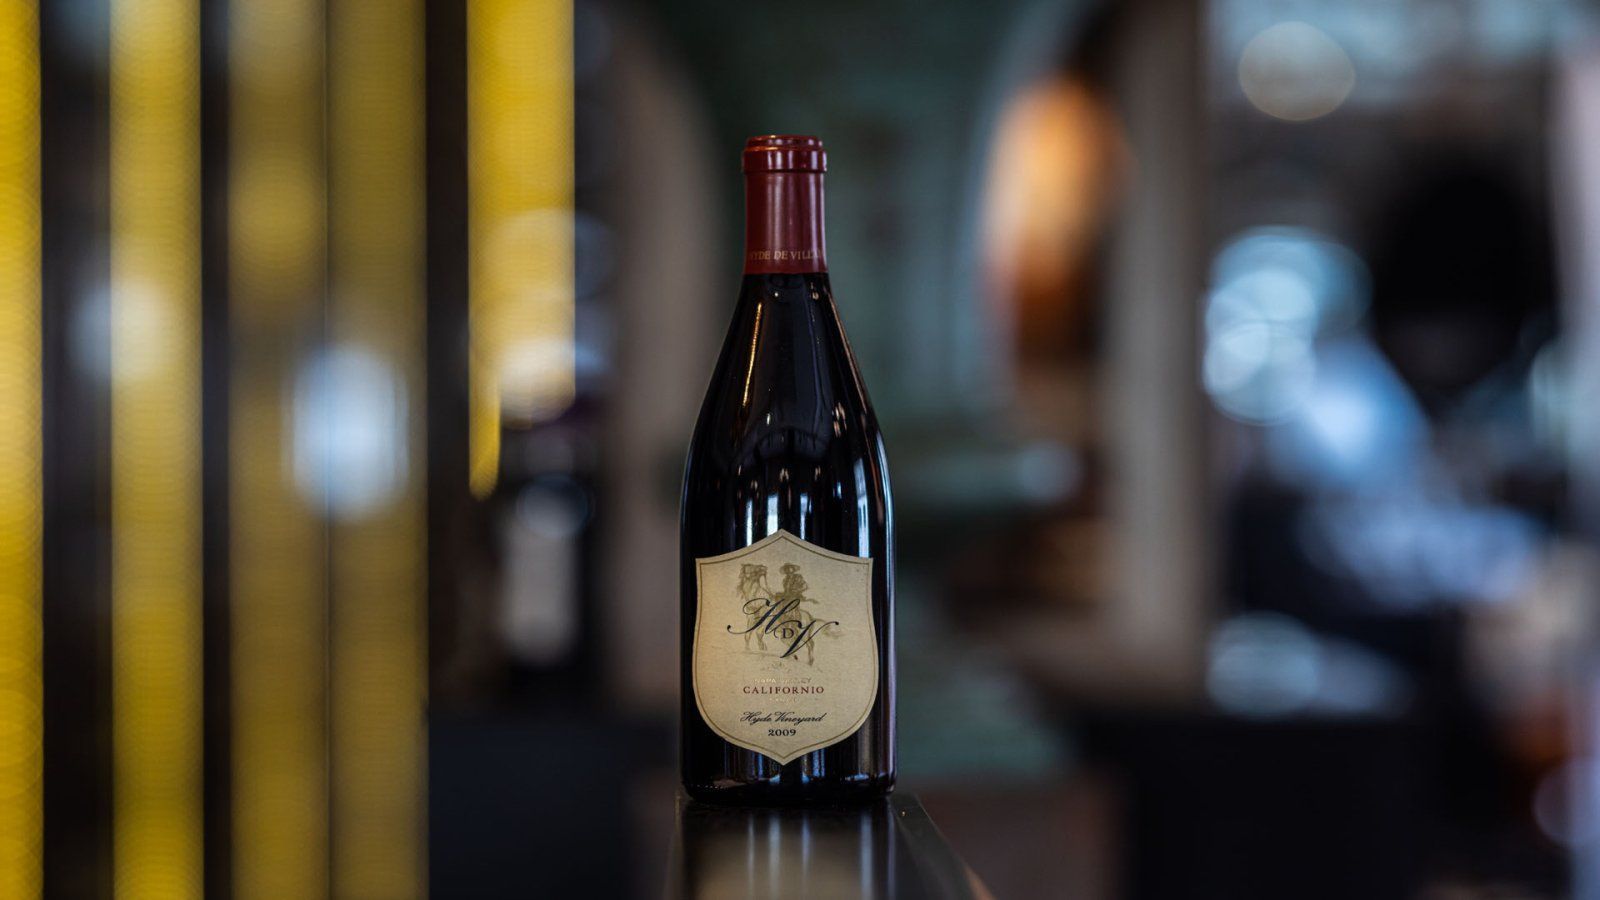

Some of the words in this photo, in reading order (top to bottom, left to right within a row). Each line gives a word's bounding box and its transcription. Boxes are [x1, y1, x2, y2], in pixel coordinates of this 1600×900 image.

[774, 250, 788, 260] DE
[742, 685, 825, 695] CALIFORNIO
[740, 711, 773, 726] Hyde
[773, 711, 828, 726] Vineyard
[767, 728, 797, 737] 2009
